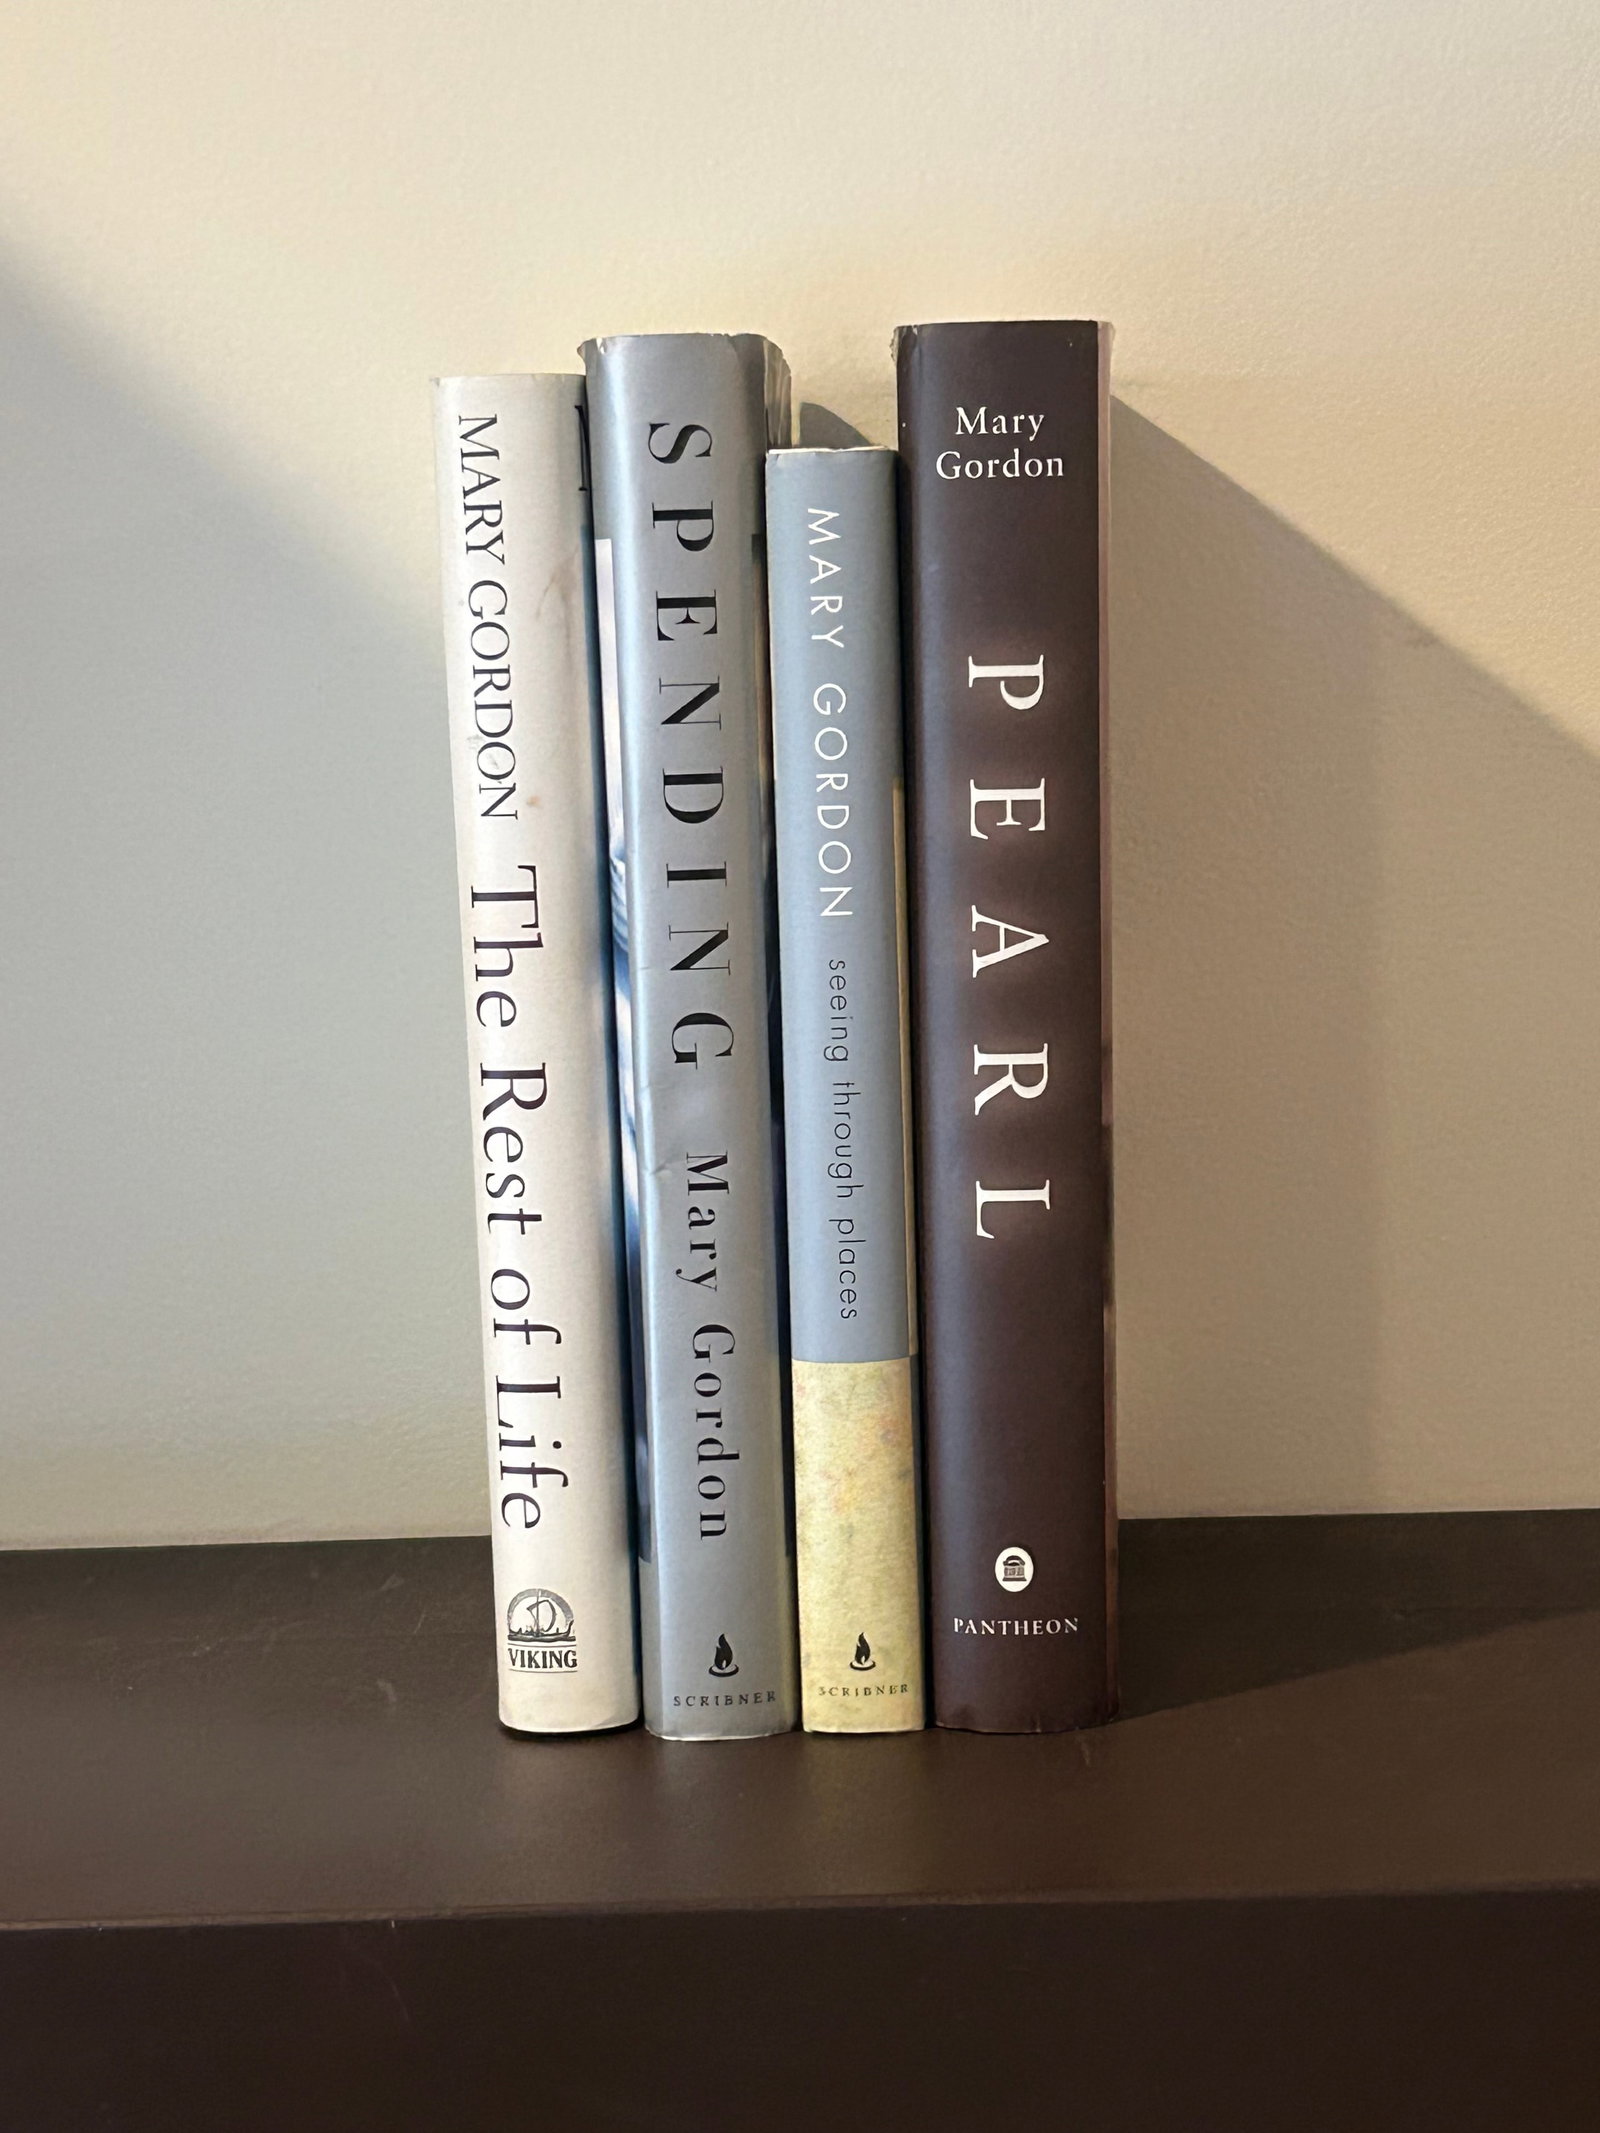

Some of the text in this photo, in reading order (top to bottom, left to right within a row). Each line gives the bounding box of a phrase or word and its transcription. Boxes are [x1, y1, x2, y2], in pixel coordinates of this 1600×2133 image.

[935, 405, 1064, 480] Mary Gordon
[808, 507, 866, 1321] MARY GORDON seeing through places
[967, 653, 1052, 1240] PEARL
[458, 414, 569, 1529] MARY GORDON The Rest of Life
[648, 423, 740, 1541] SPENDING Mary Gordon
[508, 1648, 578, 1669] VIKING
[953, 1617, 1079, 1637] PANTHEON
[674, 1690, 776, 1707] SCRIBNER
[819, 1684, 908, 1699] SCRIBNER
